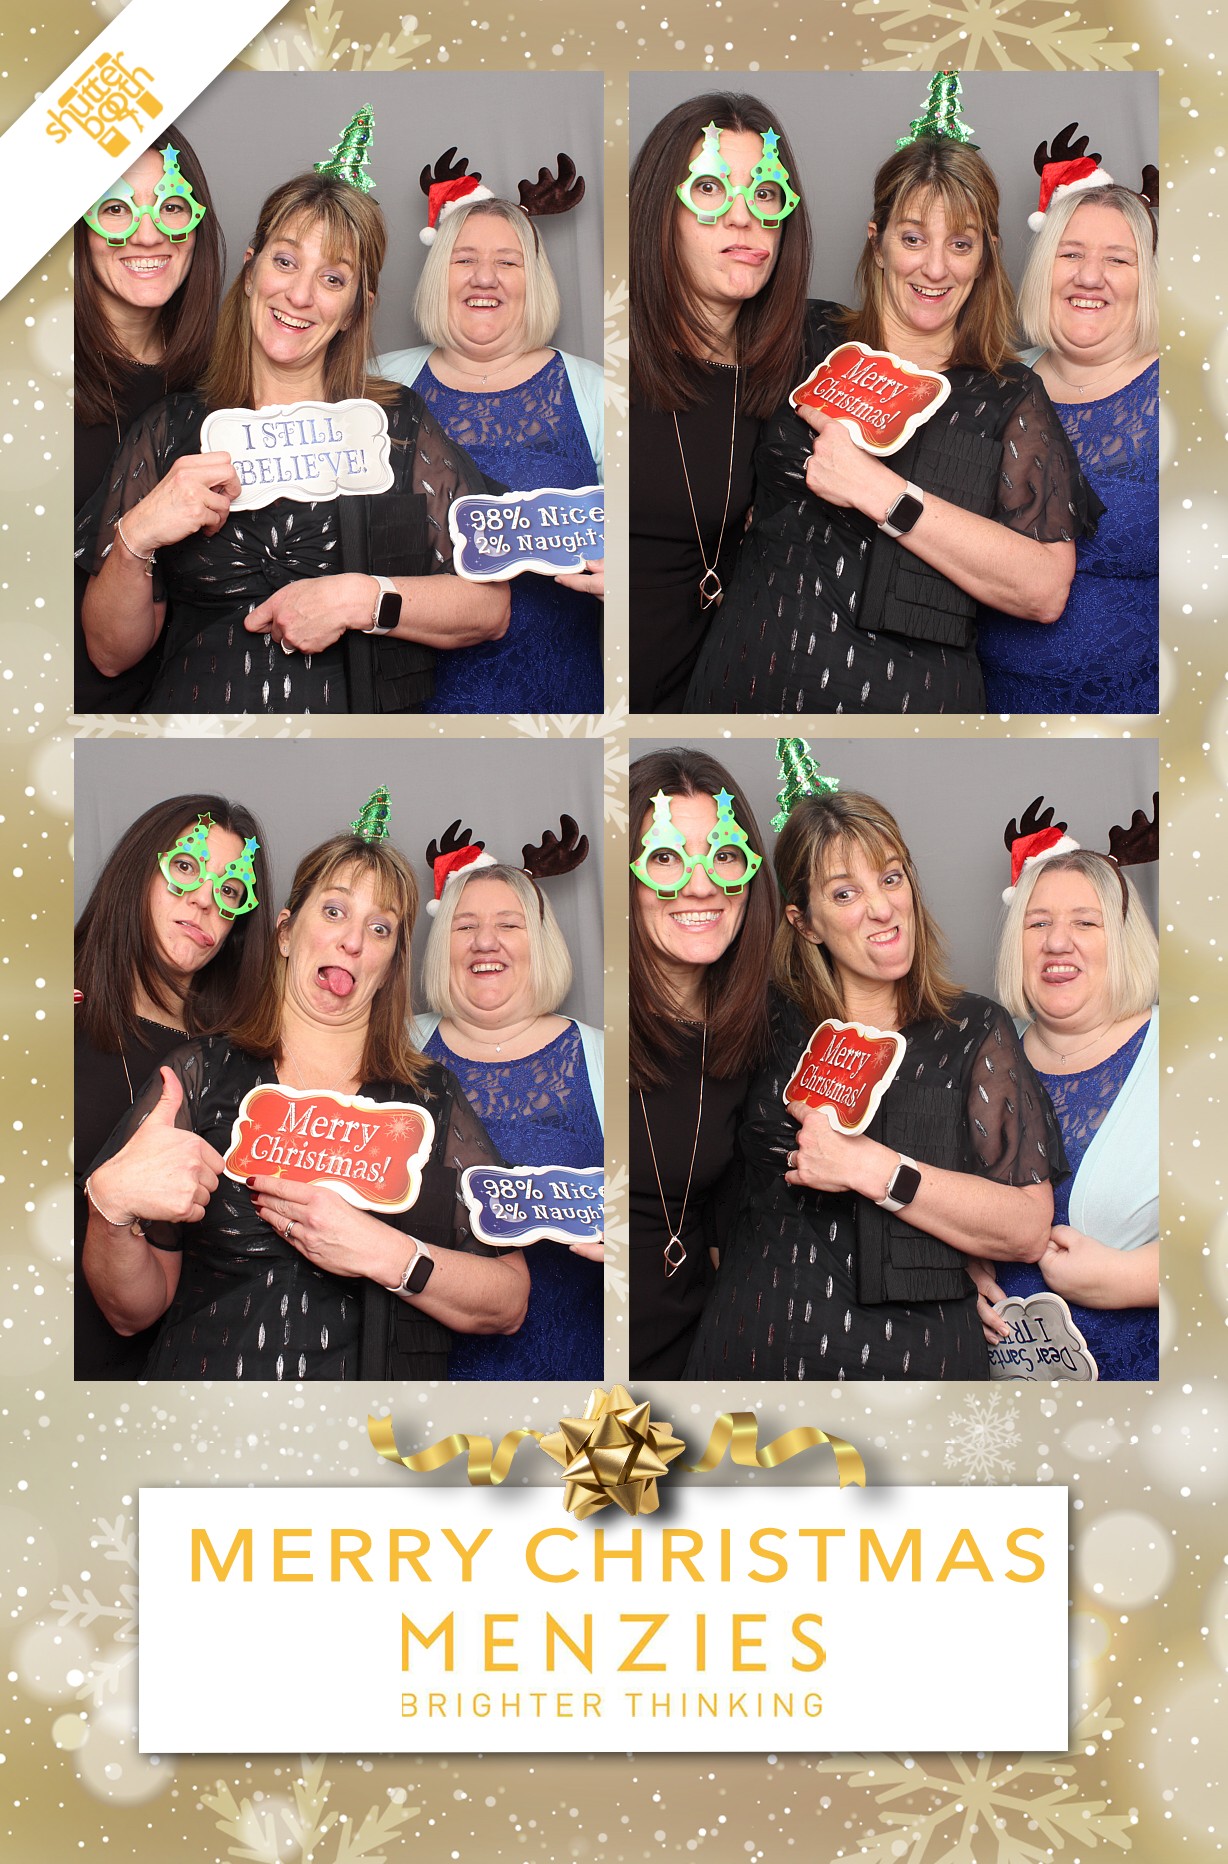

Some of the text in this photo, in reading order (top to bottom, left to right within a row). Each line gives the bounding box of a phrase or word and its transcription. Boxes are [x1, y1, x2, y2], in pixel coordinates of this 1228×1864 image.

[841, 357, 910, 404] Merry
[812, 377, 902, 430] Christmas!
[241, 417, 343, 451] I STILL
[232, 449, 368, 487] BELIEVE!
[469, 506, 531, 531] 98%
[475, 528, 605, 555] 2% Naught
[819, 1034, 872, 1080] Merry
[799, 1063, 867, 1109] Christmas!
[277, 1101, 381, 1153] Merry
[250, 1133, 393, 1184] Christmas!
[482, 1178, 544, 1200] 98%
[491, 1202, 528, 1220] 2%
[1034, 1317, 1053, 1343] I
[988, 1345, 1078, 1373] Dear Santa
